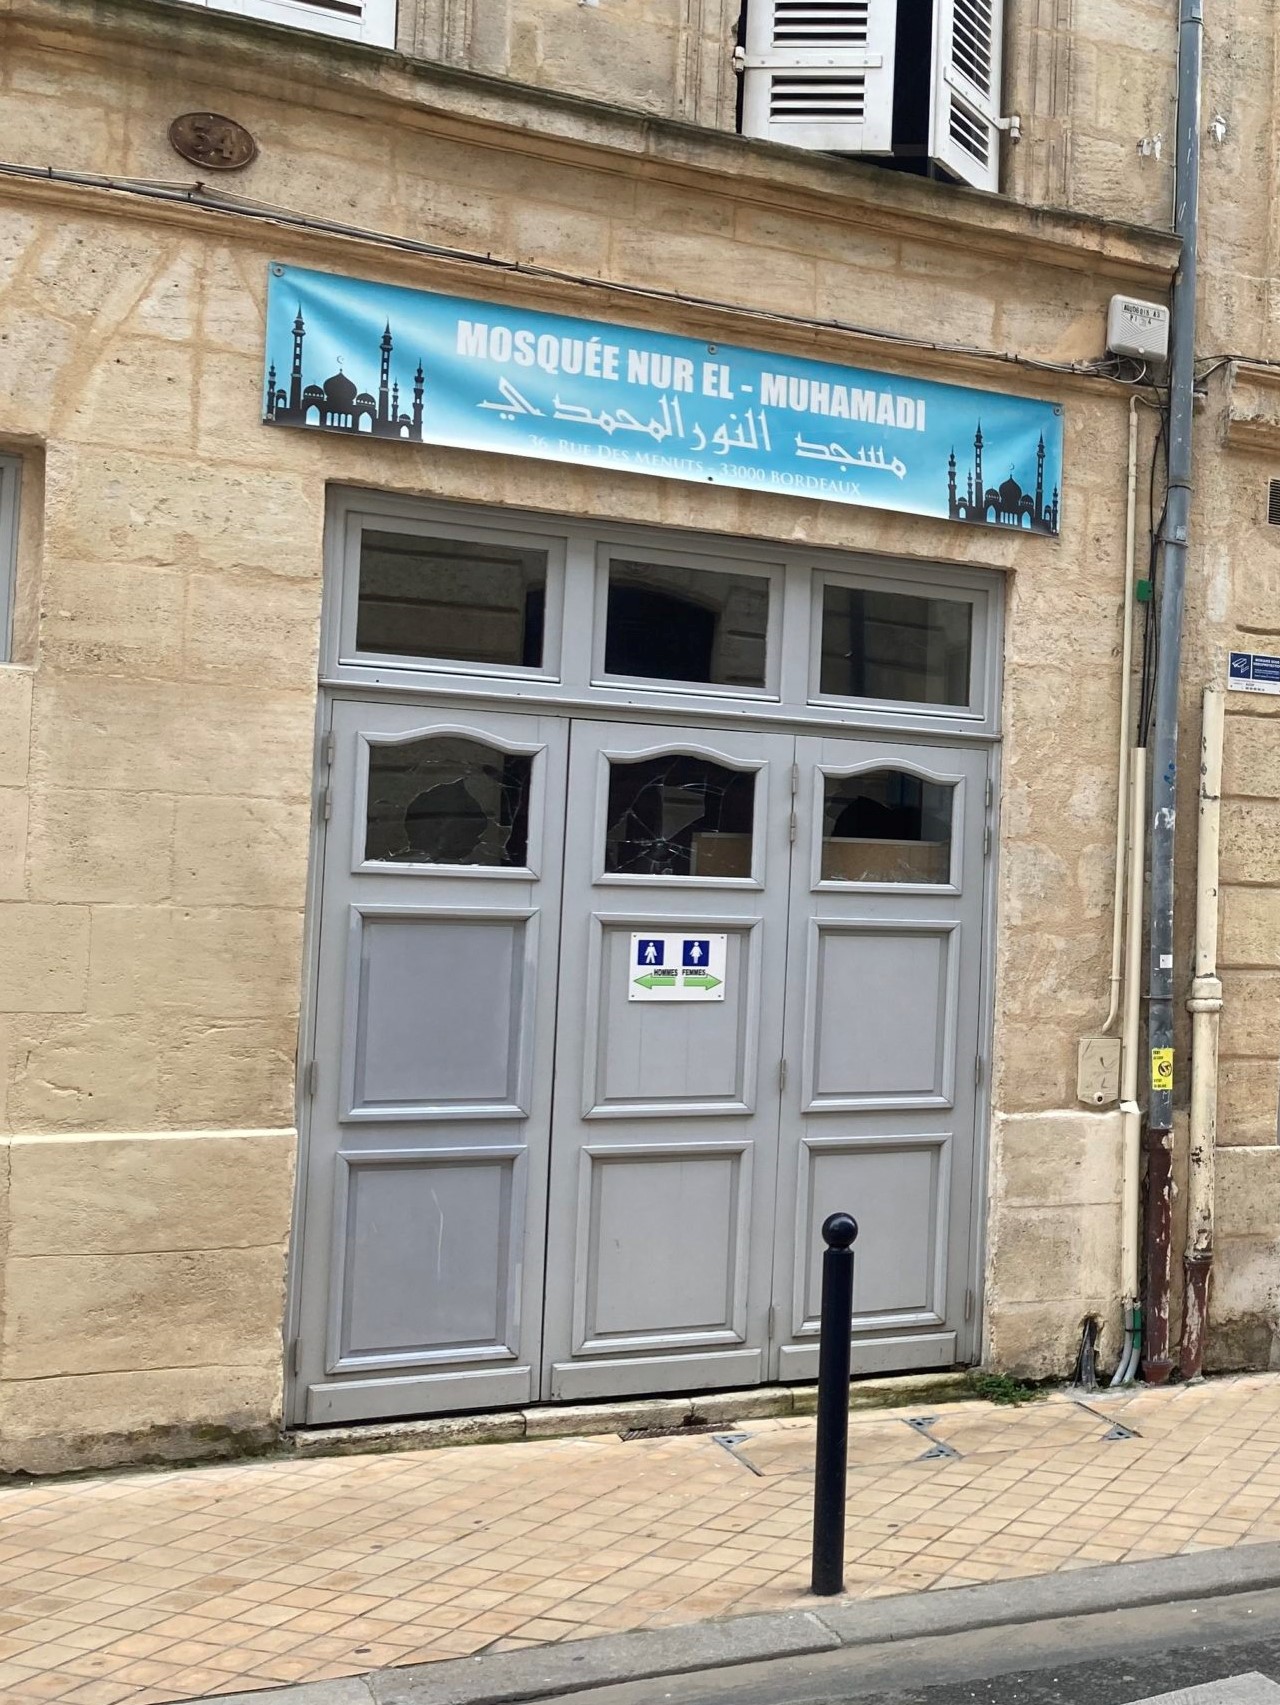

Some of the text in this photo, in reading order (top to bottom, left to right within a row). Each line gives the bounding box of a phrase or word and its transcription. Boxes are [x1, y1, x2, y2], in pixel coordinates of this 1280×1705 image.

[457, 320, 619, 380] MOSQUÉE
[628, 349, 694, 393] NUR
[702, 362, 734, 400] EL
[760, 371, 926, 432] MUHAMADI
[690, 407, 772, 455] النور
[559, 439, 591, 456] RUE
[598, 444, 630, 462] DES
[635, 451, 703, 472] MENUTS
[720, 462, 765, 481] 33000
[771, 470, 861, 496] BORDEAUX
[795, 432, 907, 480] مسجد
[653, 968, 706, 976] HOMMES FEMMES
